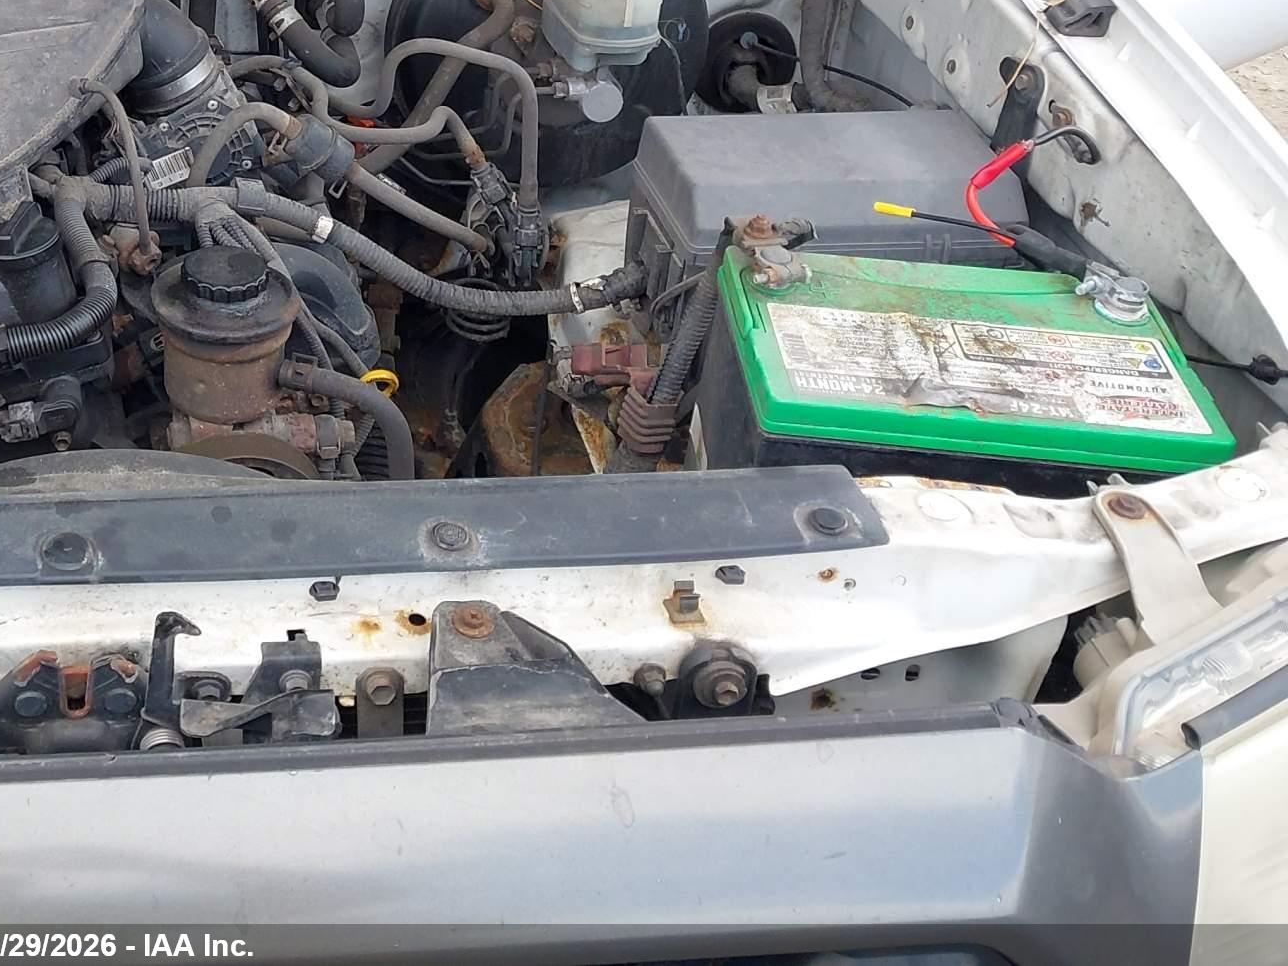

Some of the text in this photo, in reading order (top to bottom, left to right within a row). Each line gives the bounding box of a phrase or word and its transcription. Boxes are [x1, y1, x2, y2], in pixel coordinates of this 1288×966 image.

[797, 377, 886, 395] 24-MONTH
[1089, 380, 1168, 394] AUTOMOTIVE
[1095, 402, 1184, 418] INTERSTATE
[1097, 397, 1178, 411] BATTERIES
